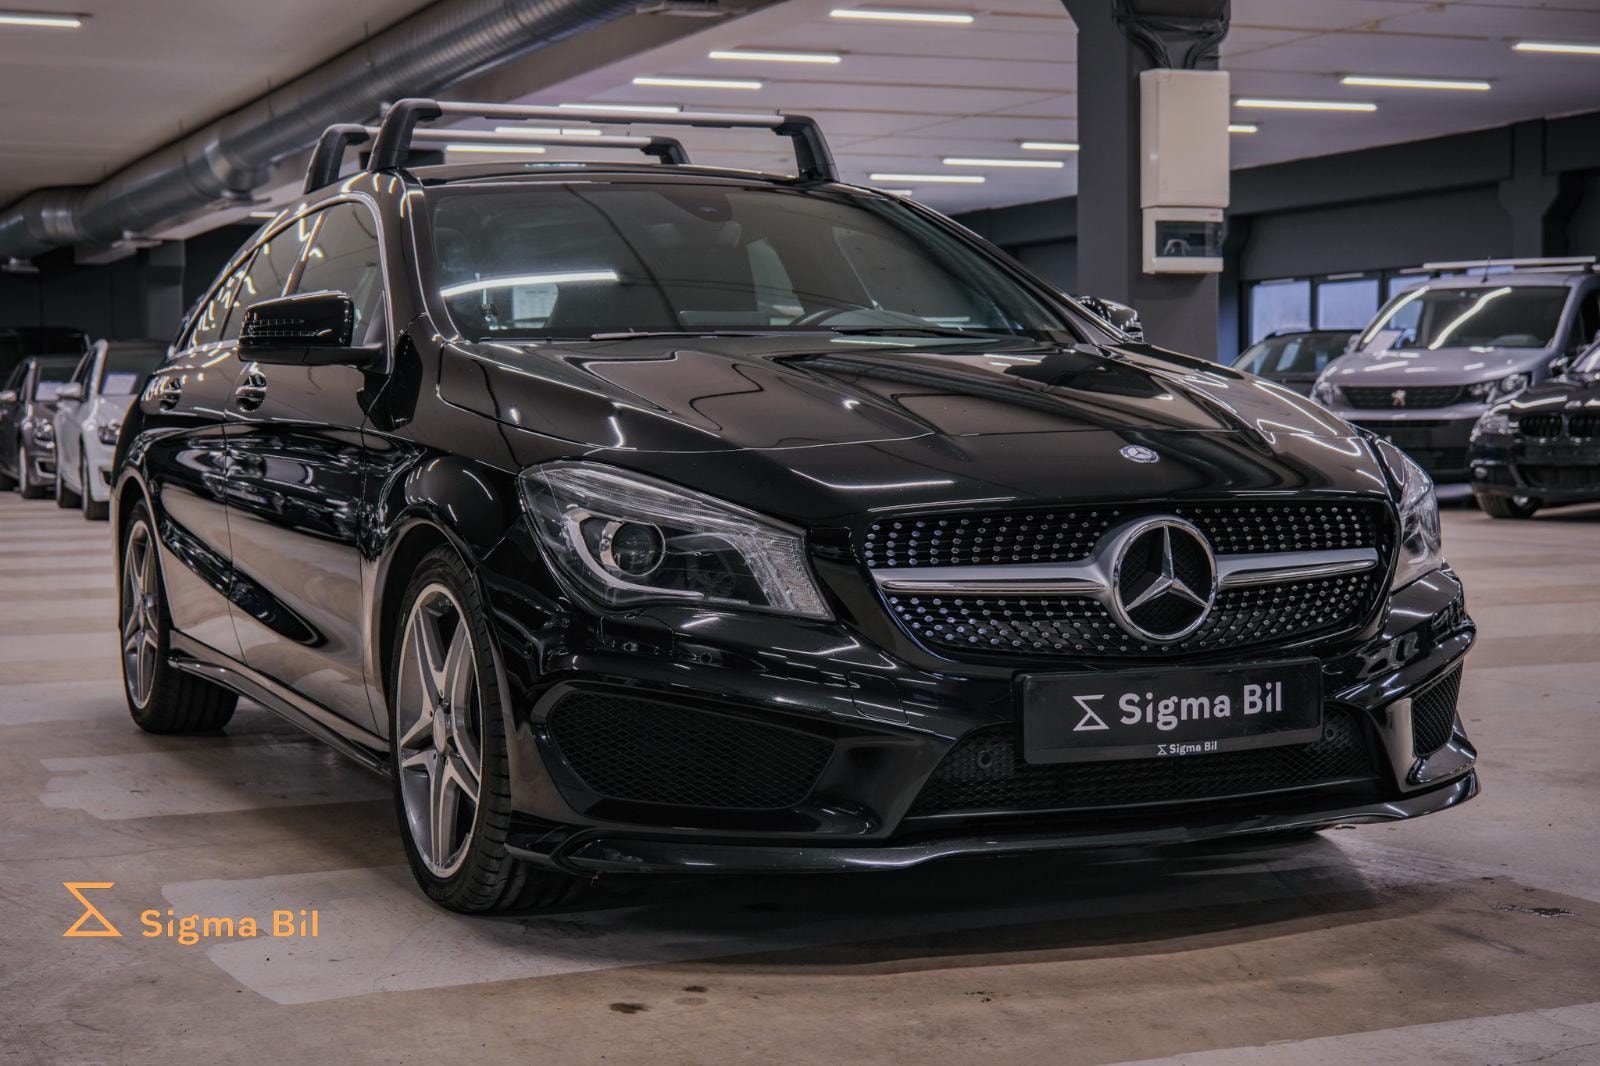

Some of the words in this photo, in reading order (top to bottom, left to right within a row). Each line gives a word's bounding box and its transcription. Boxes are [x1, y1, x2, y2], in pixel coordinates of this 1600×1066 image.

[1118, 691, 1231, 731] Sigma
[1243, 681, 1282, 715] Bil
[1169, 742, 1202, 756] Sigma
[1204, 740, 1218, 752] Bil
